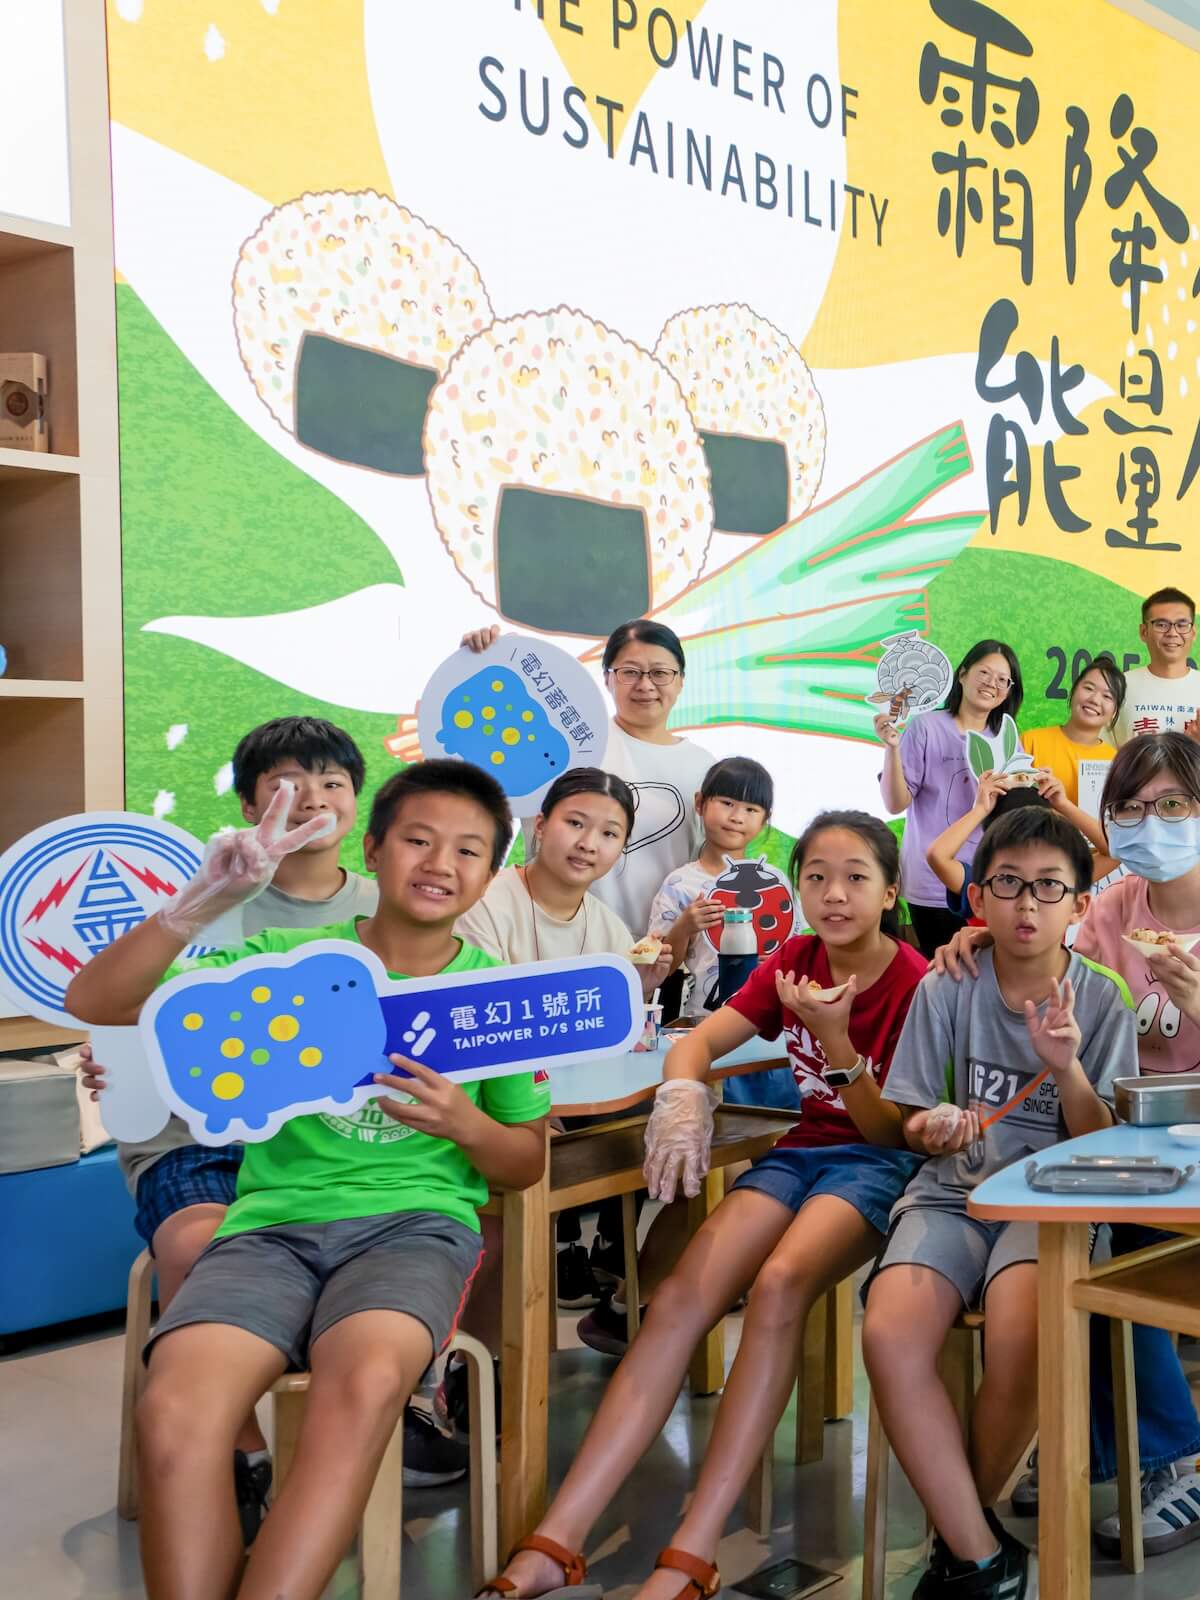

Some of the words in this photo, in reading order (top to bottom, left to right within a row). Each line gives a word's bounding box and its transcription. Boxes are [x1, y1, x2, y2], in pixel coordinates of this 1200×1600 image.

[613, 0, 786, 114] POWER
[806, 73, 858, 137] OF
[478, 55, 889, 247] SUSTAINABILITY
[520, 652, 594, 747] 電幻蓄電獸
[1135, 704, 1173, 712] TAIWAN
[450, 987, 602, 1031] 電幻1號所
[453, 1028, 533, 1050] TAIPOWER
[539, 1022, 569, 1037] D/S
[574, 1016, 605, 1032] ONE
[1023, 1097, 1055, 1115] SINCE
[1039, 1082, 1058, 1098] SPO
